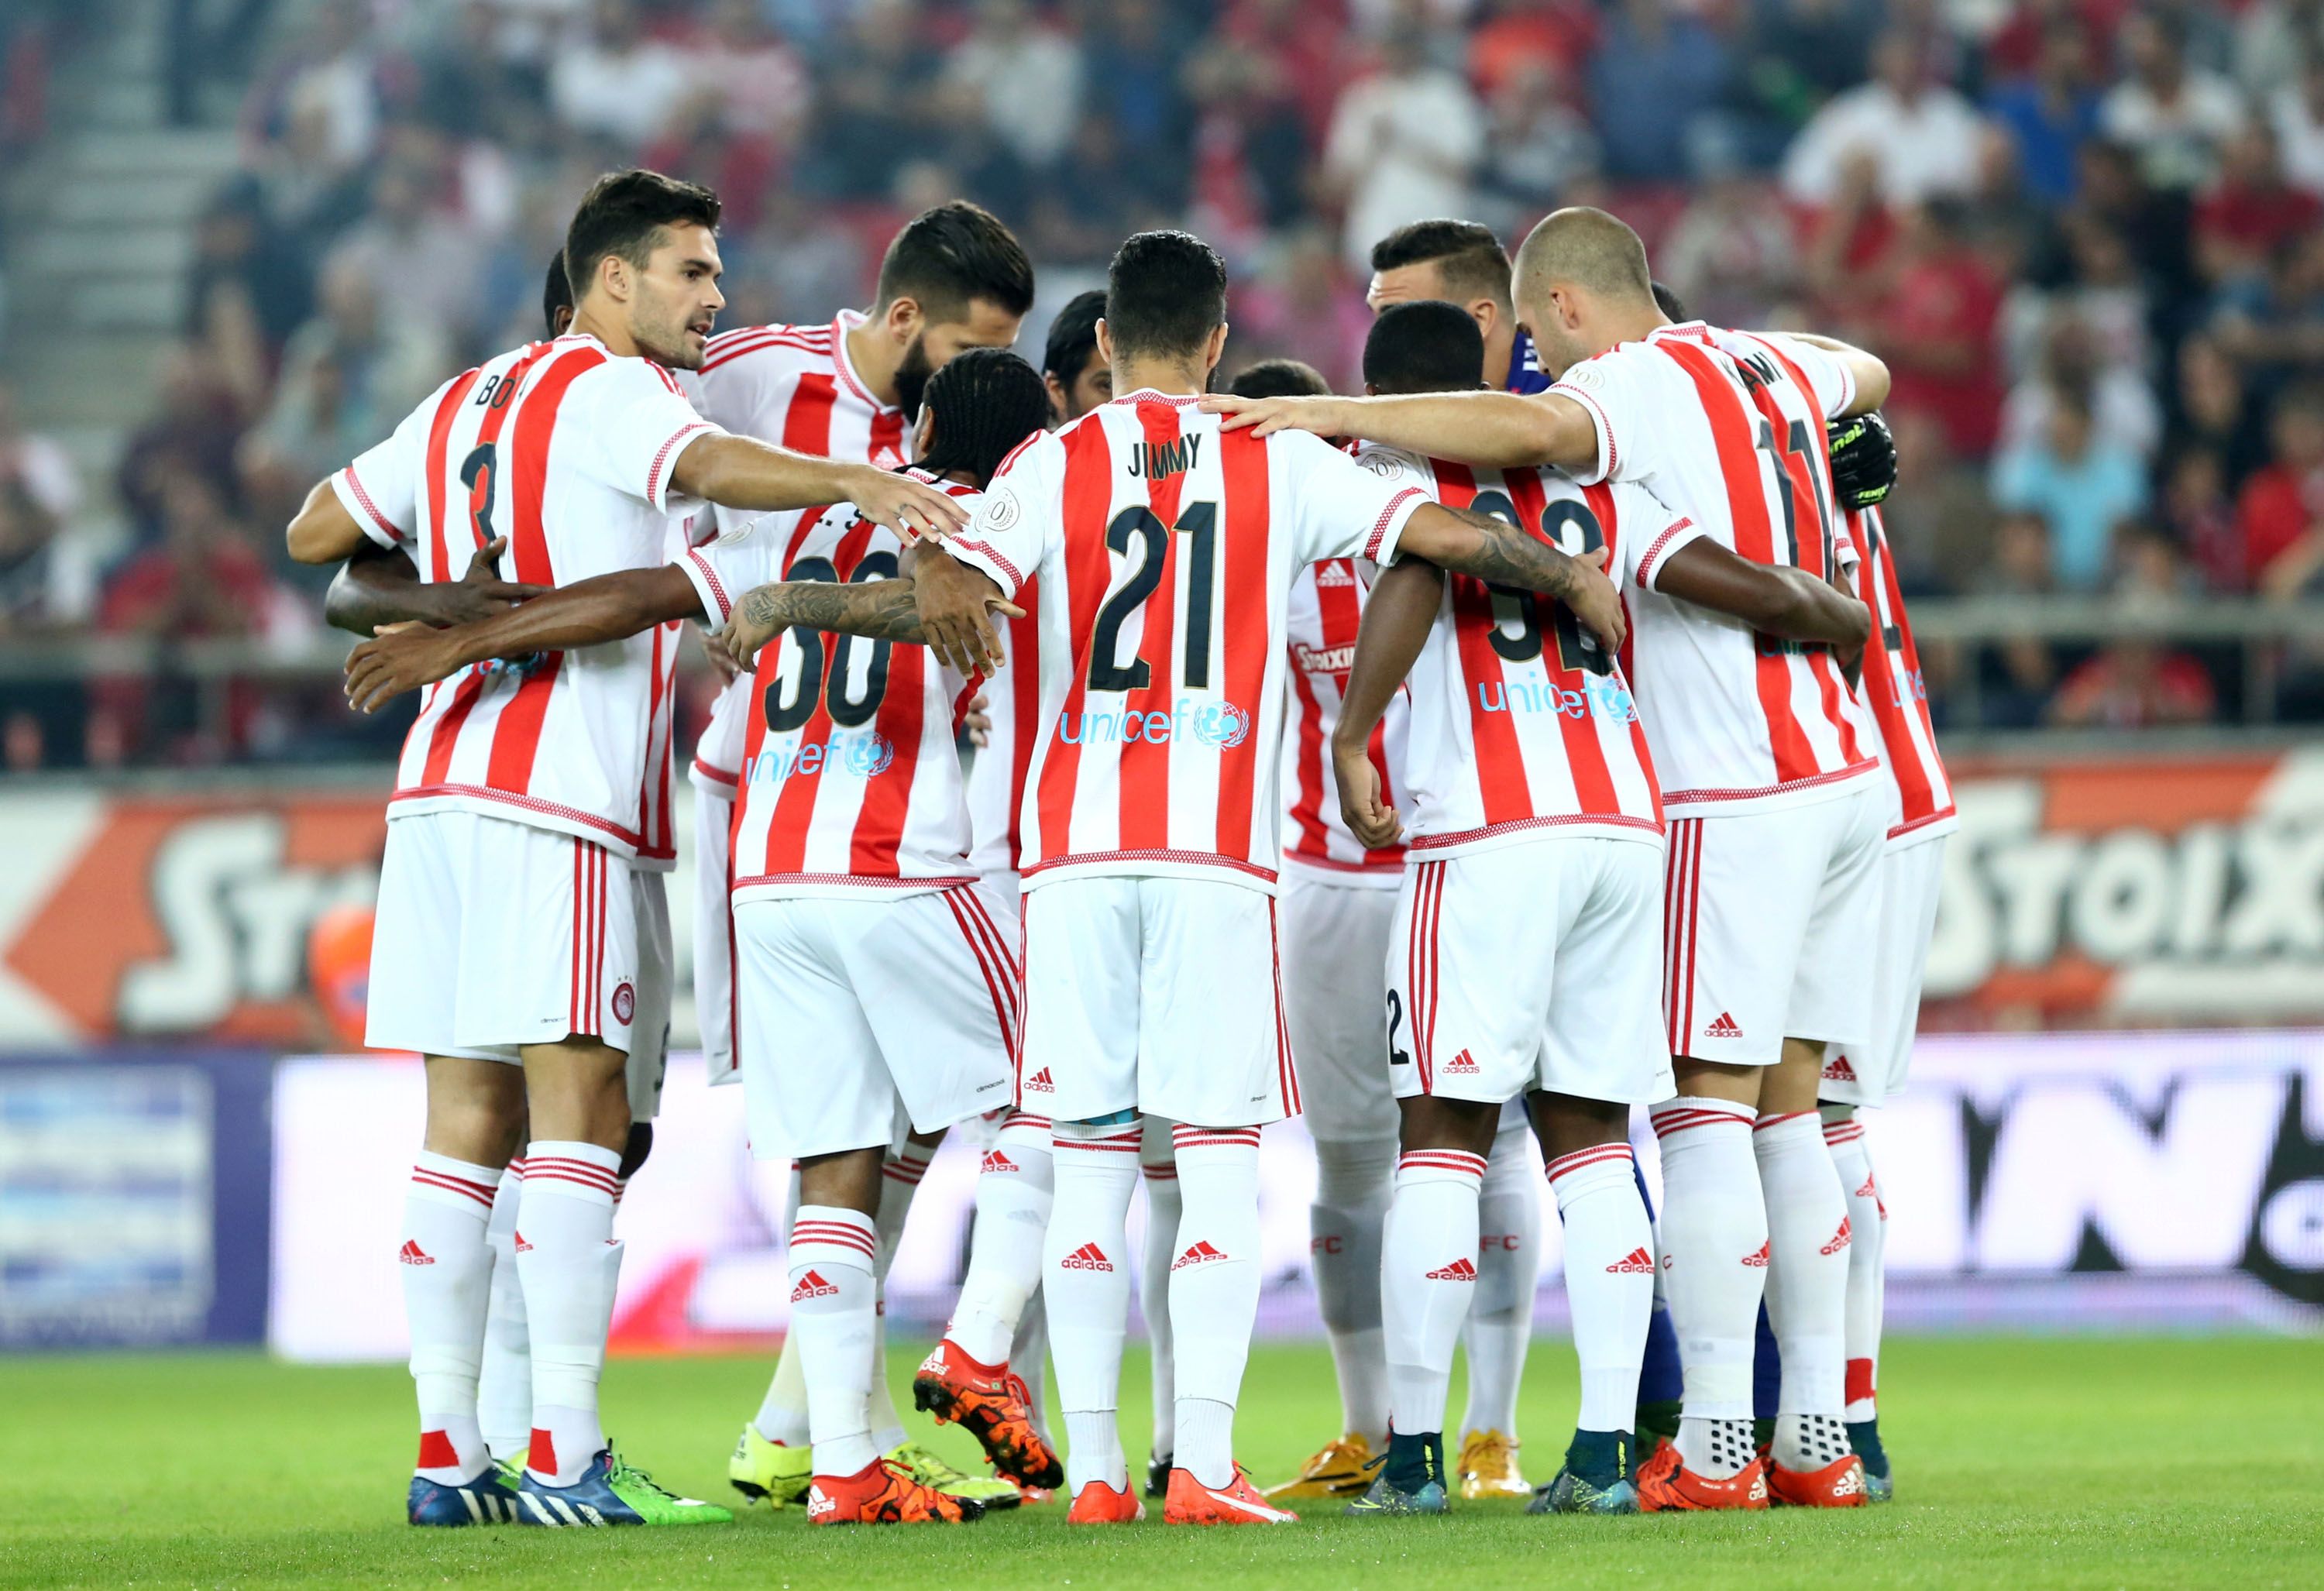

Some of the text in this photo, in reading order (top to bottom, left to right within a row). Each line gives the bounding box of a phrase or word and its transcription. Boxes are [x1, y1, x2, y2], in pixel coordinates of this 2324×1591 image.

[1128, 433, 1202, 481] JIMMY
[1087, 500, 1219, 692] 21
[1478, 671, 1597, 720] unicef
[1060, 699, 1190, 746] unicef
[1387, 988, 1409, 1064] 2
[1704, 1029, 1743, 1038] adidas
[1061, 1258, 1114, 1273] adidas
[1425, 1271, 1479, 1282] adida
[1605, 1264, 1656, 1275] adida
